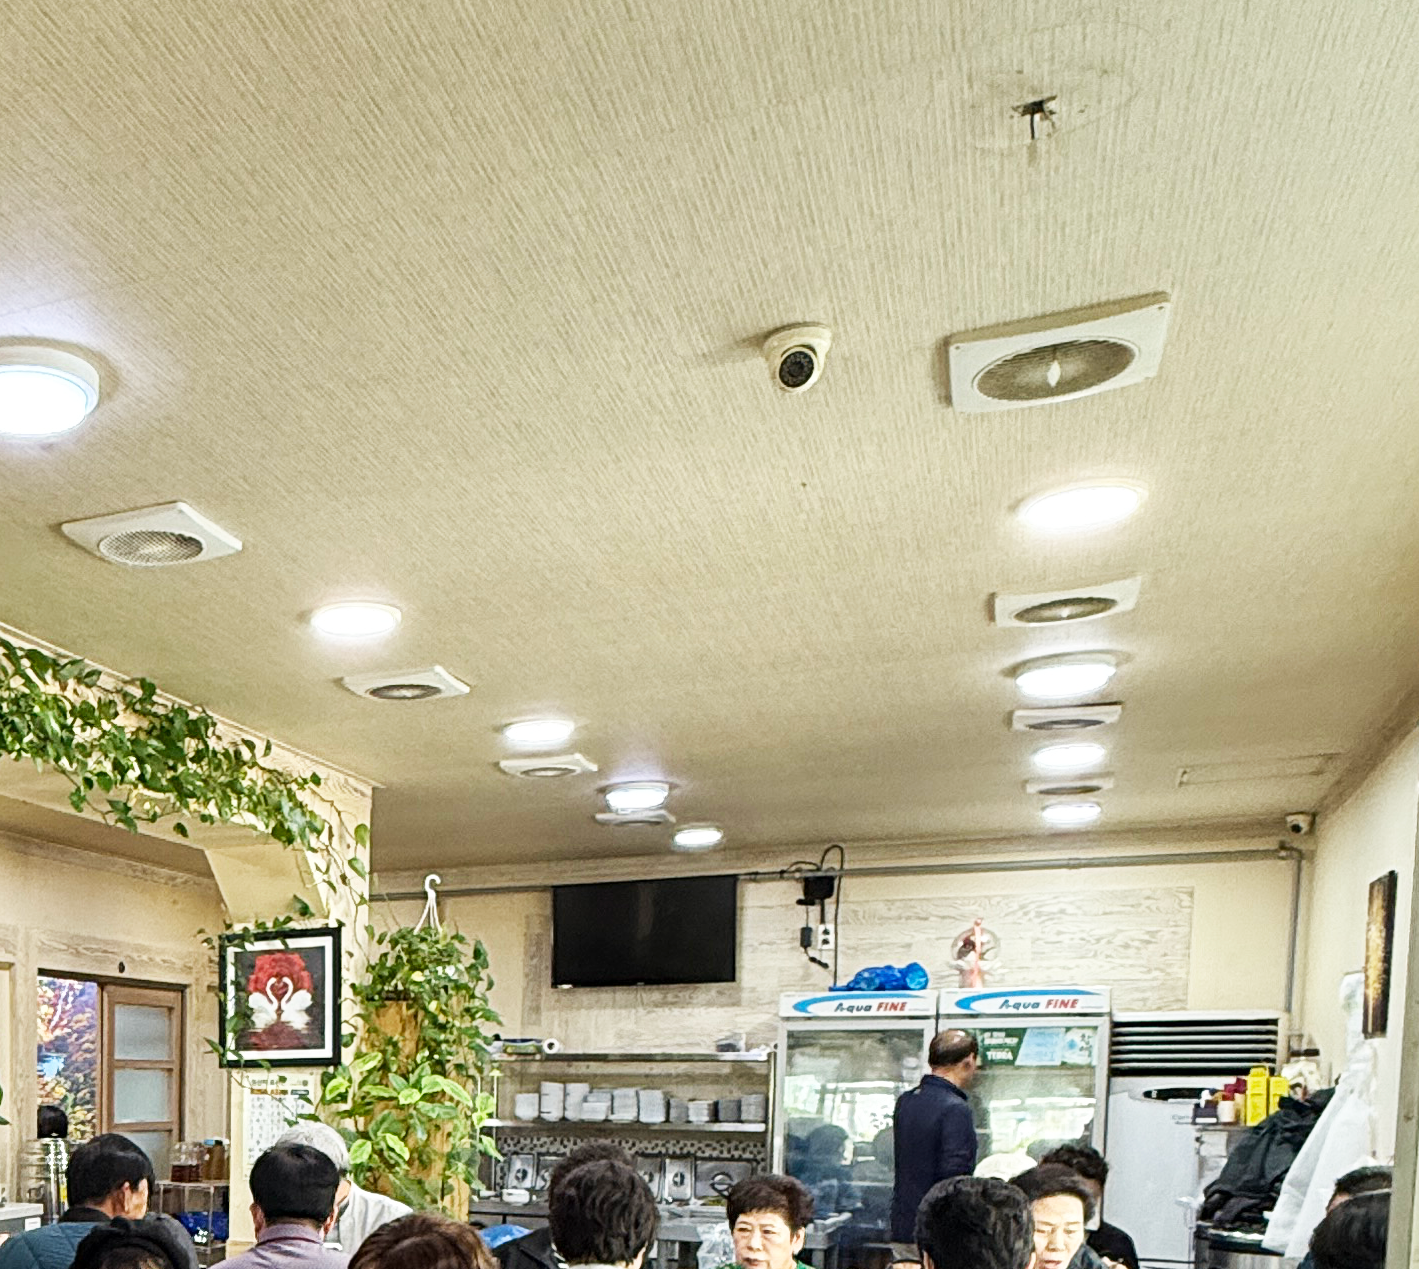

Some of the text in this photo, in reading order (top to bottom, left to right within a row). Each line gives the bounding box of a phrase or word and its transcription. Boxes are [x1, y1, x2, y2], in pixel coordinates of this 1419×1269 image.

[834, 1002, 907, 1013] Aqua FINE
[998, 999, 1041, 1010] Aqua
[1045, 999, 1080, 1009] FINE
